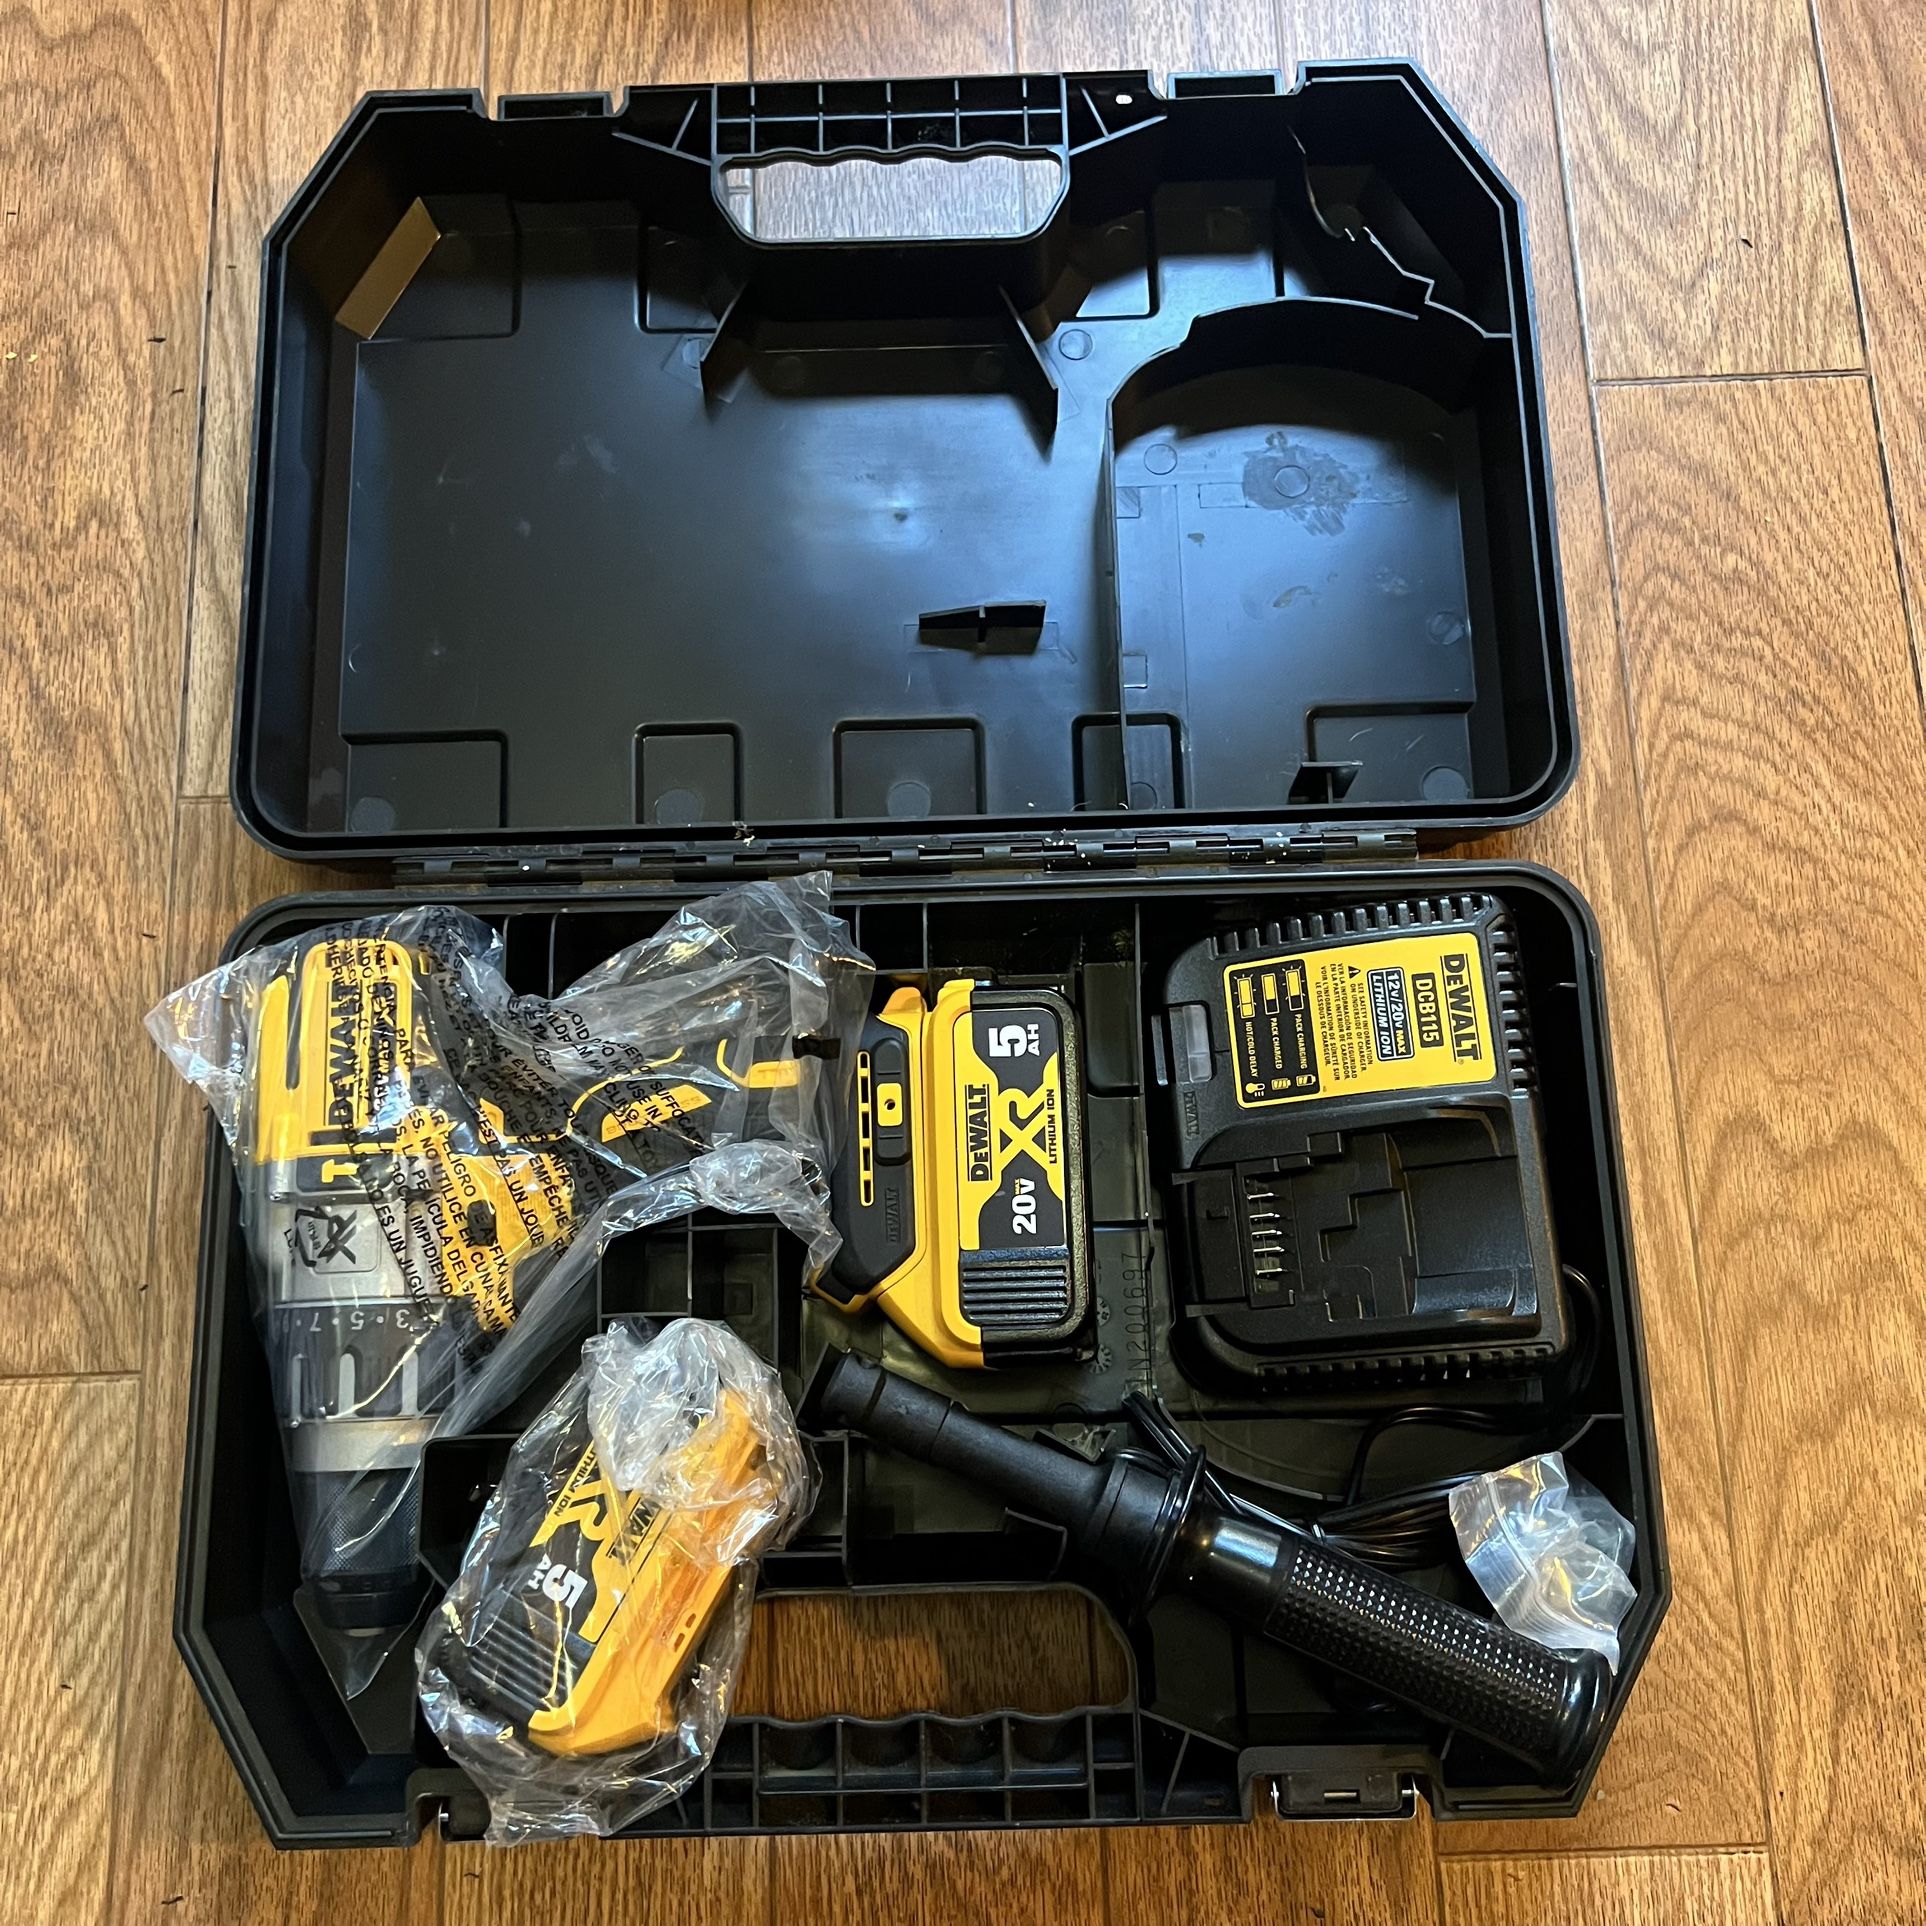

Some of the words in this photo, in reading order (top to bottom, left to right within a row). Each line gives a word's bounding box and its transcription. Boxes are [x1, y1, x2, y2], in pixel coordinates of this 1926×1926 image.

[1330, 963, 1336, 972] EN
[1331, 973, 1337, 981] LA
[1339, 976, 1345, 984] LA
[1332, 983, 1340, 1002] PARTE
[1350, 983, 1356, 992] ON
[1372, 975, 1388, 1027] LITHIUM
[1316, 990, 1325, 1020] DESSOUS
[1322, 982, 1334, 1030] L'INFORMATION
[1328, 1032, 1335, 1041] DE
[1335, 1004, 1344, 1032] INFERIOR
[1340, 985, 1352, 1031] INFORMACIÓN
[1351, 993, 1361, 1030] UNDERSIDE
[1359, 995, 1367, 1018] SAFETY
[1415, 978, 1439, 1041] DCB115
[1443, 953, 1477, 1061] DEWALT
[1270, 1017, 1278, 1034] PACK
[1294, 1014, 1302, 1031] PACK
[1320, 1021, 1326, 1030] DE
[1346, 1032, 1352, 1040] DE
[1356, 1031, 1362, 1039] OF
[988, 1024, 1028, 1057] 5
[1244, 1021, 1255, 1054] HOT/COLD
[1272, 1034, 1282, 1069] CHARGED
[1296, 1033, 1307, 1068] CHARGING
[1339, 1034, 1345, 1042] DE
[1362, 1019, 1373, 1064] INFORMATION
[1379, 1030, 1391, 1055] ION
[1395, 1029, 1406, 1053] MAX
[1249, 1056, 1258, 1077] DELAY
[1347, 1042, 1357, 1078] SEGURIDAD
[511, 1056, 558, 1097] ÉVITER
[625, 1079, 651, 1107] USE
[644, 1103, 662, 1121] IN
[1046, 1089, 1054, 1109] ION
[968, 1084, 989, 1181] DEWALT
[998, 1086, 1046, 1172] XR
[1047, 1114, 1057, 1163] LITHIUM
[401, 1144, 419, 1166] LA
[437, 1130, 477, 1198] PELIGRO
[418, 1137, 437, 1160] NO
[430, 1162, 466, 1224] UTILICE
[458, 1225, 476, 1248] EN
[507, 1180, 528, 1203] UN
[1011, 1177, 1036, 1234] 20V
[376, 1204, 395, 1226] ES
[386, 1229, 406, 1253] UN
[310, 1312, 322, 1332] 7
[350, 1310, 364, 1330] 5
[396, 1309, 410, 1328] 3
[553, 1494, 570, 1517] ION
[537, 1559, 589, 1610] 5
